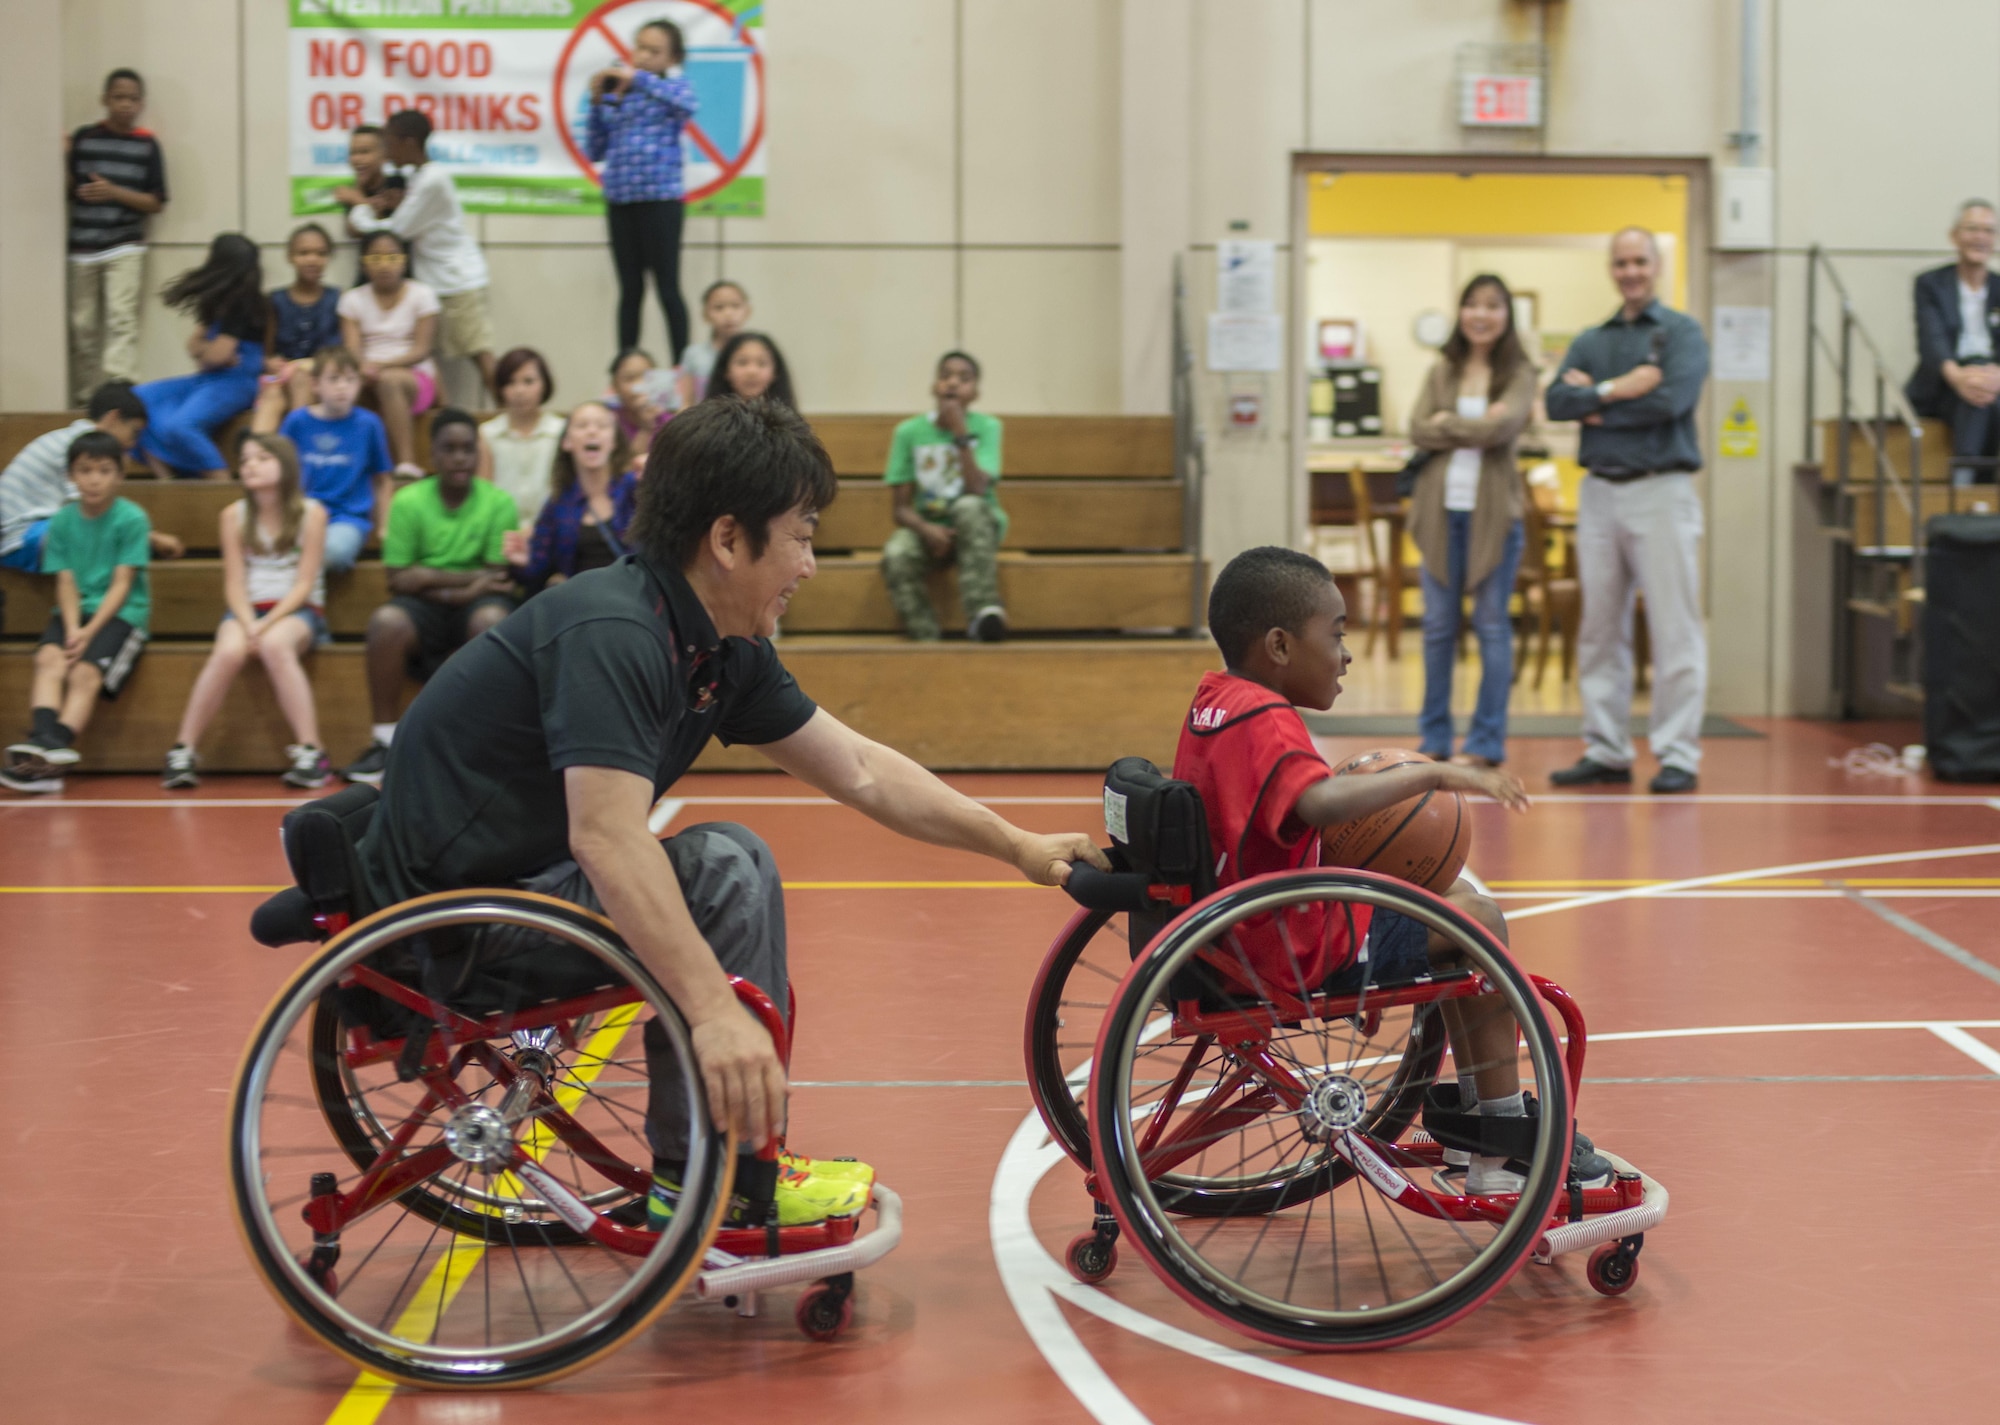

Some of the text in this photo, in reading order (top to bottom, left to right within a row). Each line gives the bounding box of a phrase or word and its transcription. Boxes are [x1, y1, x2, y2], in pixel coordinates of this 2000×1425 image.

[309, 40, 493, 78] NO FOOD
[310, 92, 364, 130] OR
[1475, 79, 1530, 121] EXIT
[1374, 1168, 1399, 1190] School
